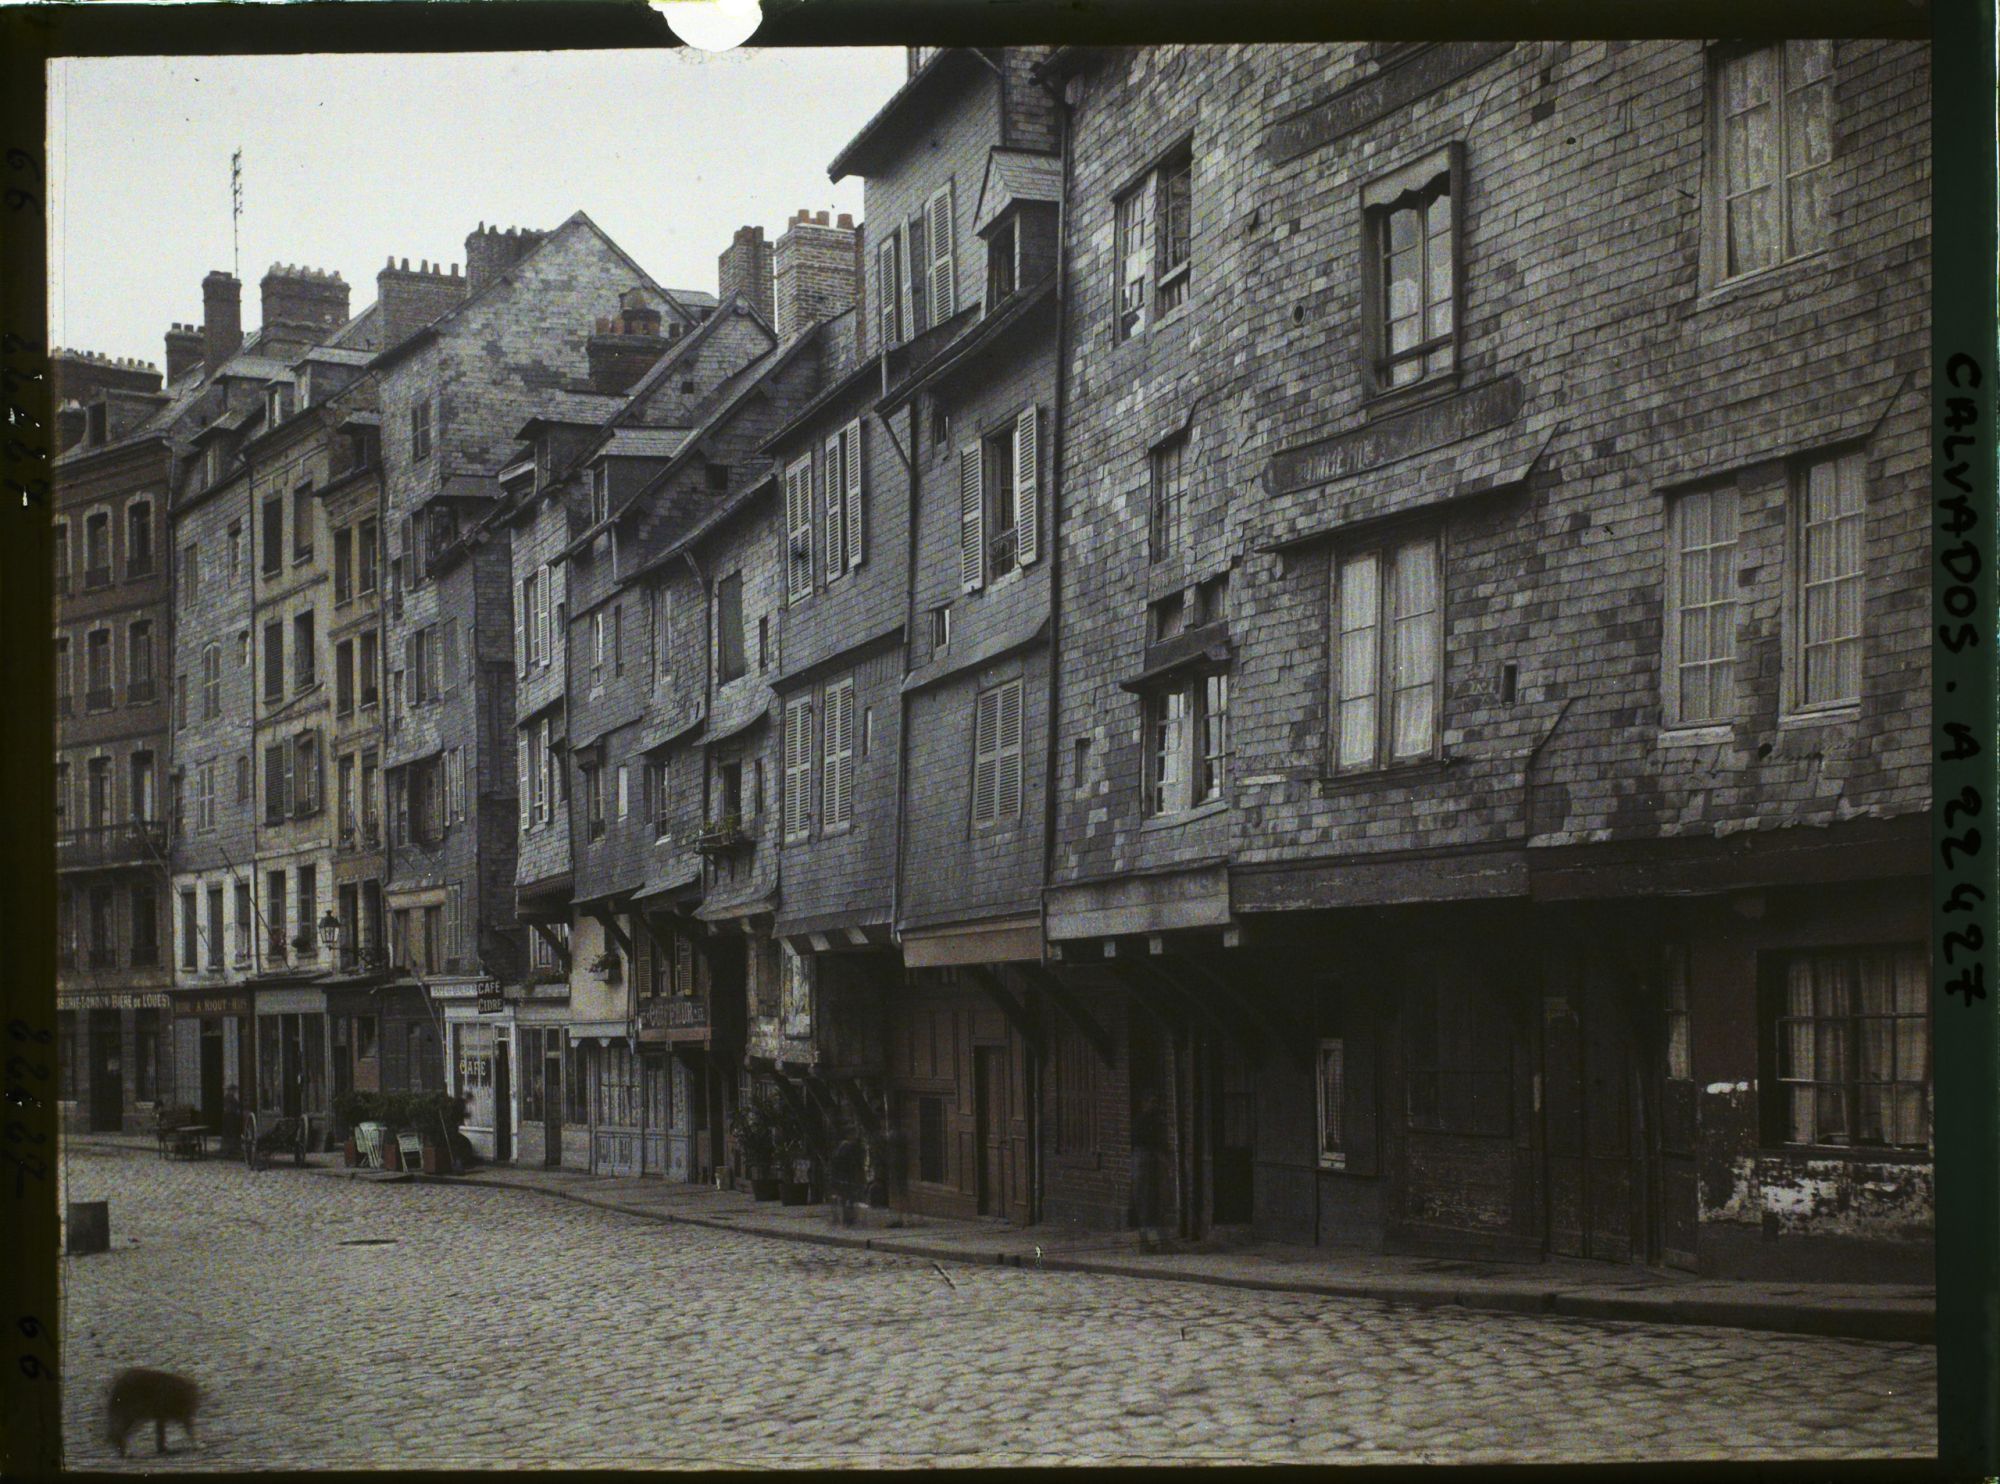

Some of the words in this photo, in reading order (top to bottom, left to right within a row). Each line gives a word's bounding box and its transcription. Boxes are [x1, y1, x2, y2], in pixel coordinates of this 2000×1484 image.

[1937, 351, 1983, 654] CALVADOS
[1940, 722, 1981, 761] A
[1938, 785, 1986, 1007] 22427
[478, 998, 503, 1012] CIDRE
